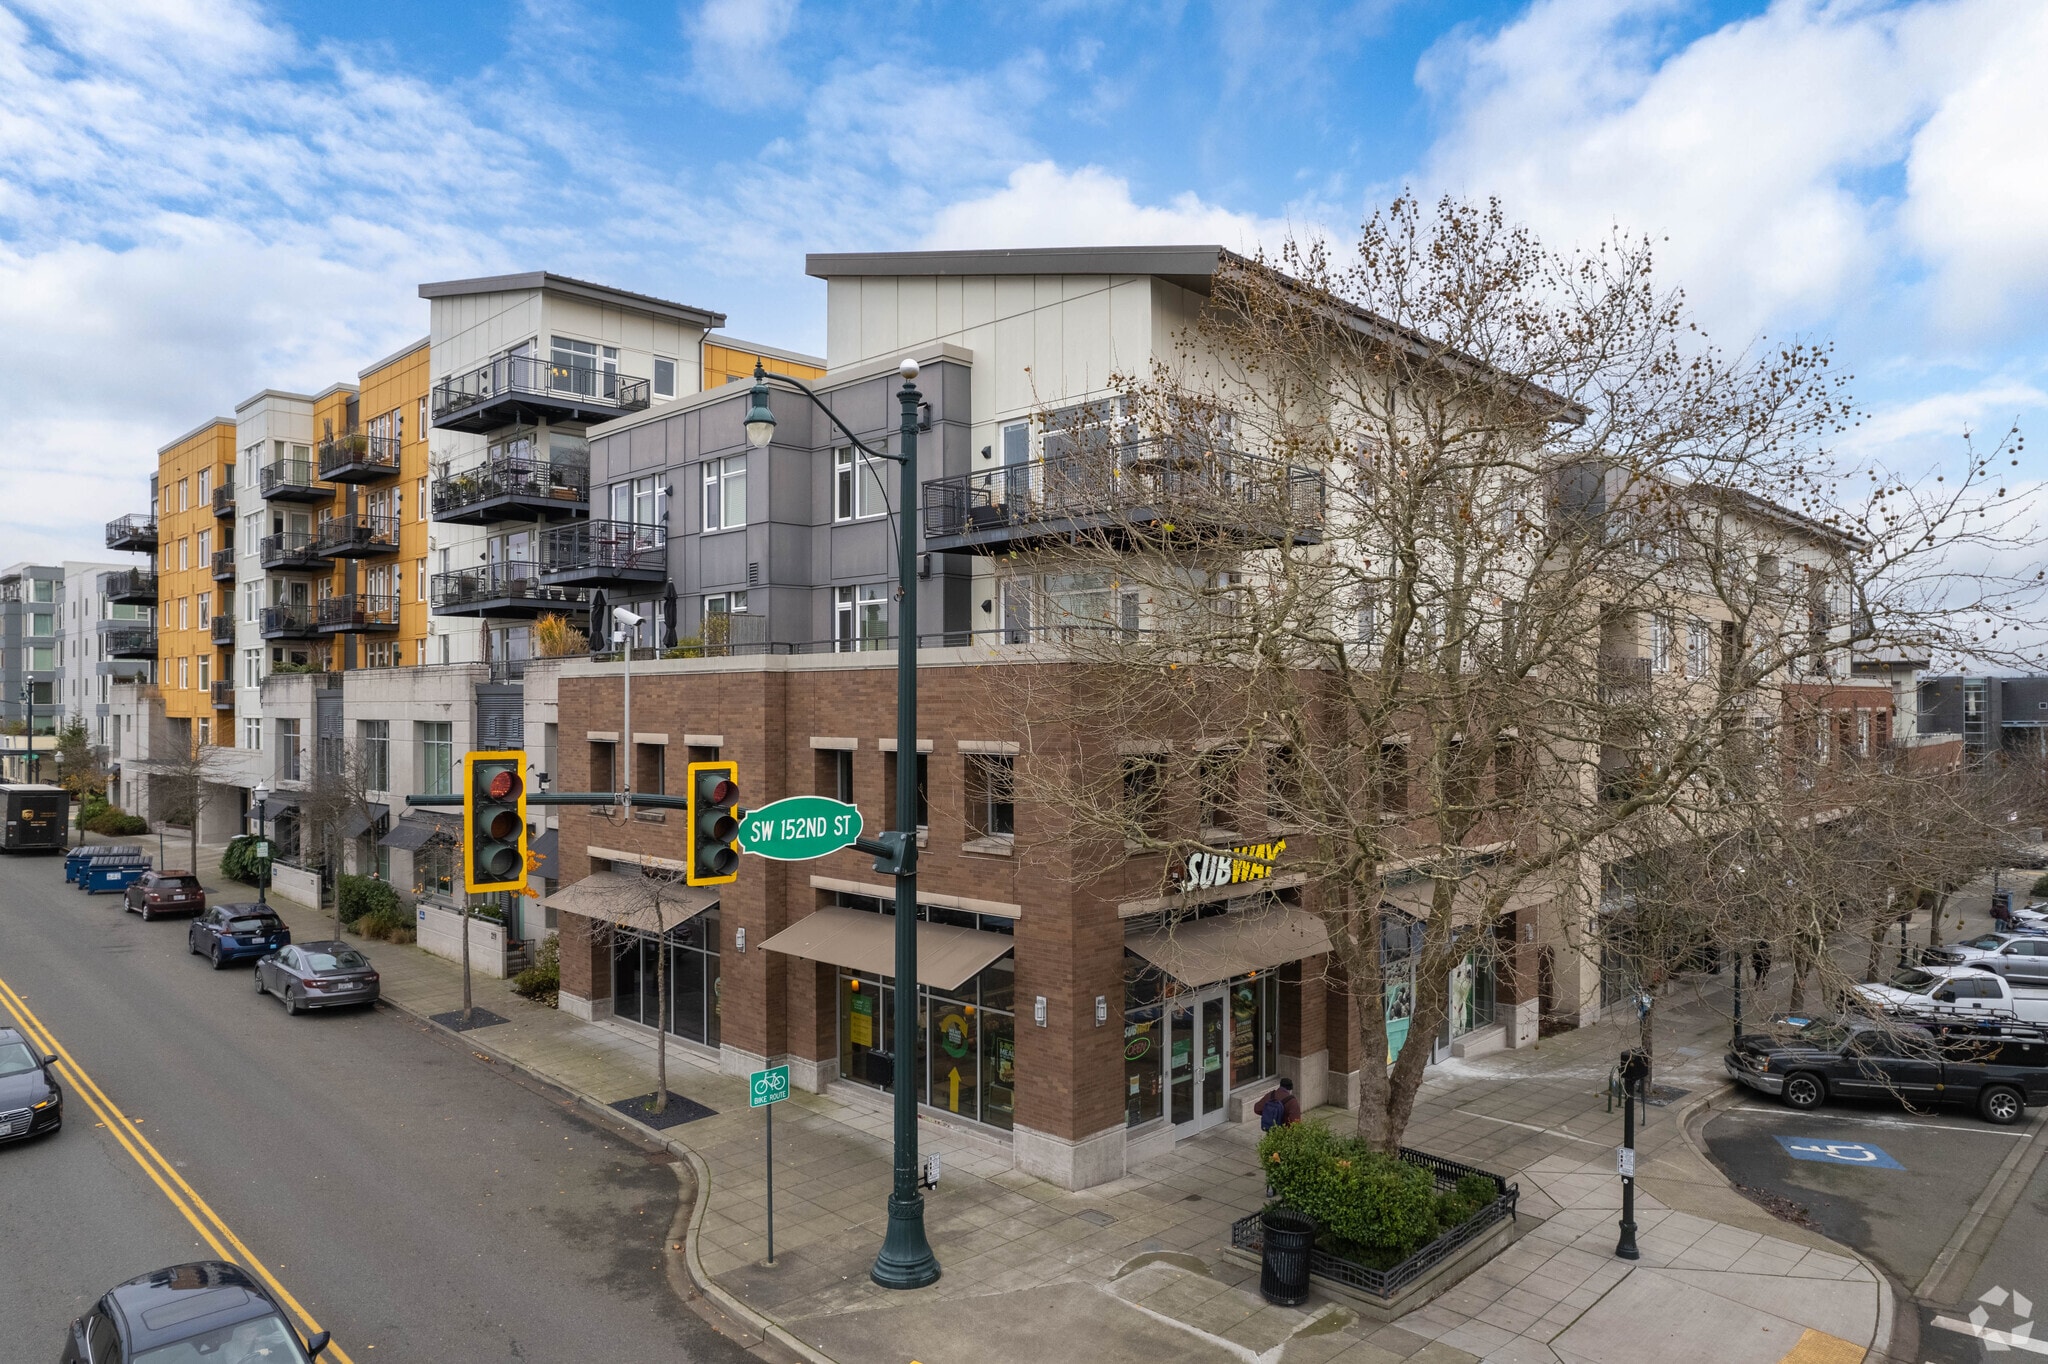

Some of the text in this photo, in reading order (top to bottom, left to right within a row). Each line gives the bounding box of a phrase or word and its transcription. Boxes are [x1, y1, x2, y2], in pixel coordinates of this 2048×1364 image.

[750, 815, 852, 843] SW 152ND ST
[1182, 838, 1287, 892] SUBWAY
[1127, 1039, 1147, 1056] OPEN
[754, 1091, 786, 1104] BIKE ROUTE
